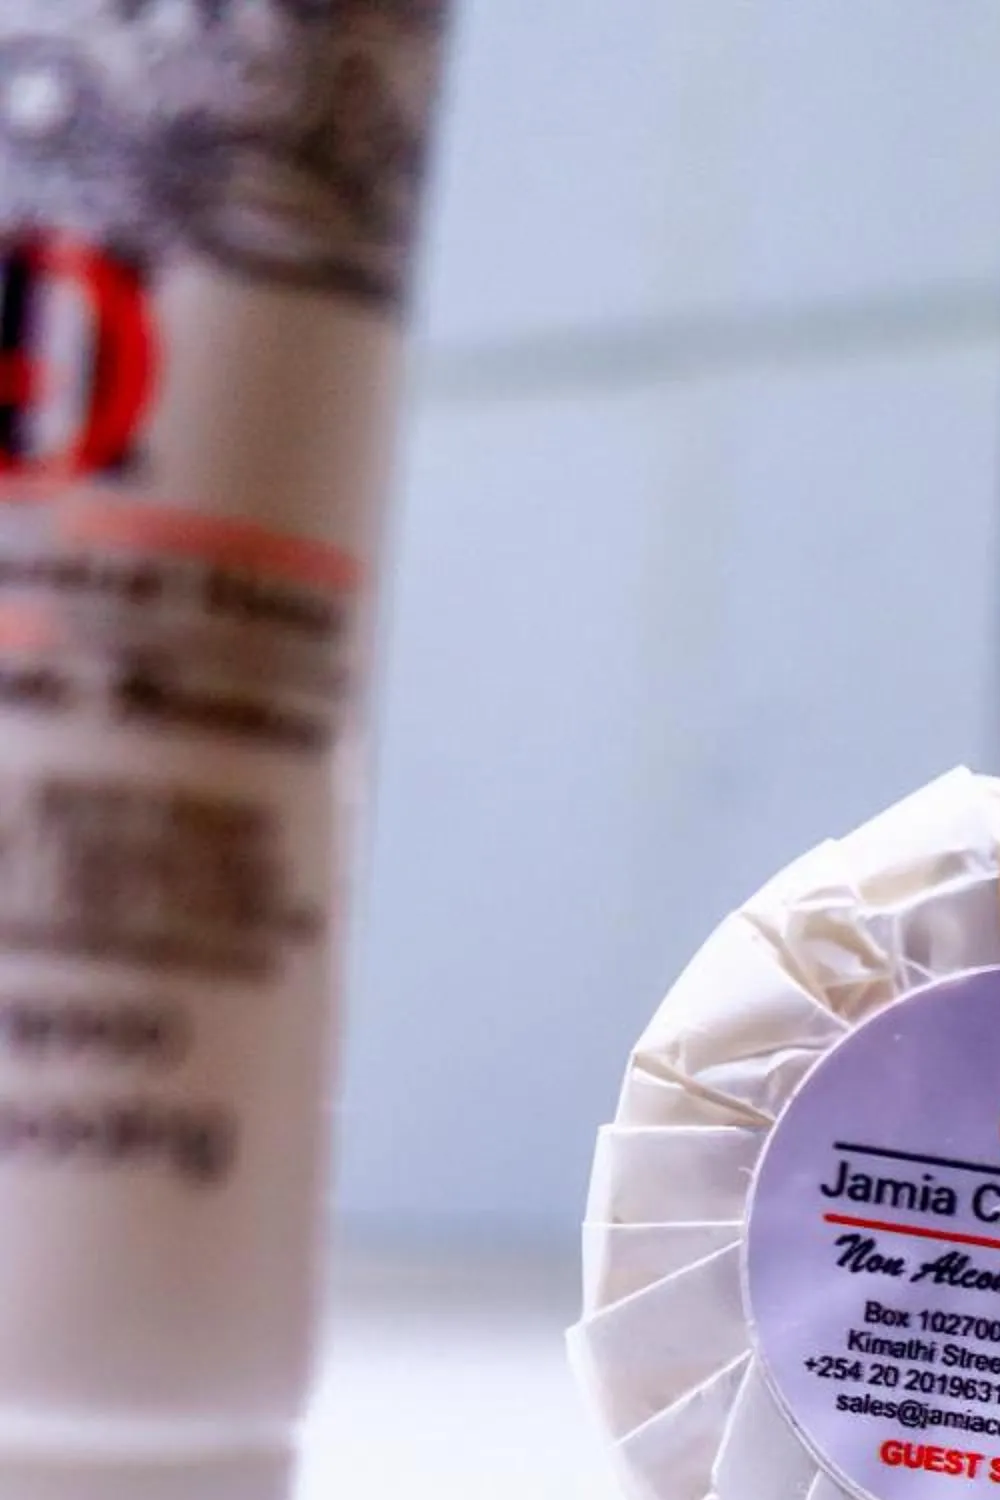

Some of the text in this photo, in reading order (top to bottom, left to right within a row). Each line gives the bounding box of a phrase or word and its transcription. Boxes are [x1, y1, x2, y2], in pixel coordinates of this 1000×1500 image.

[819, 1160, 957, 1217] Jamia
[834, 1233, 905, 1277] Non
[864, 1300, 910, 1328] Box
[847, 1329, 936, 1363] Kimathi
[803, 1355, 862, 1382] +254
[867, 1363, 900, 1388] 20
[879, 1439, 985, 1480] GUEST
